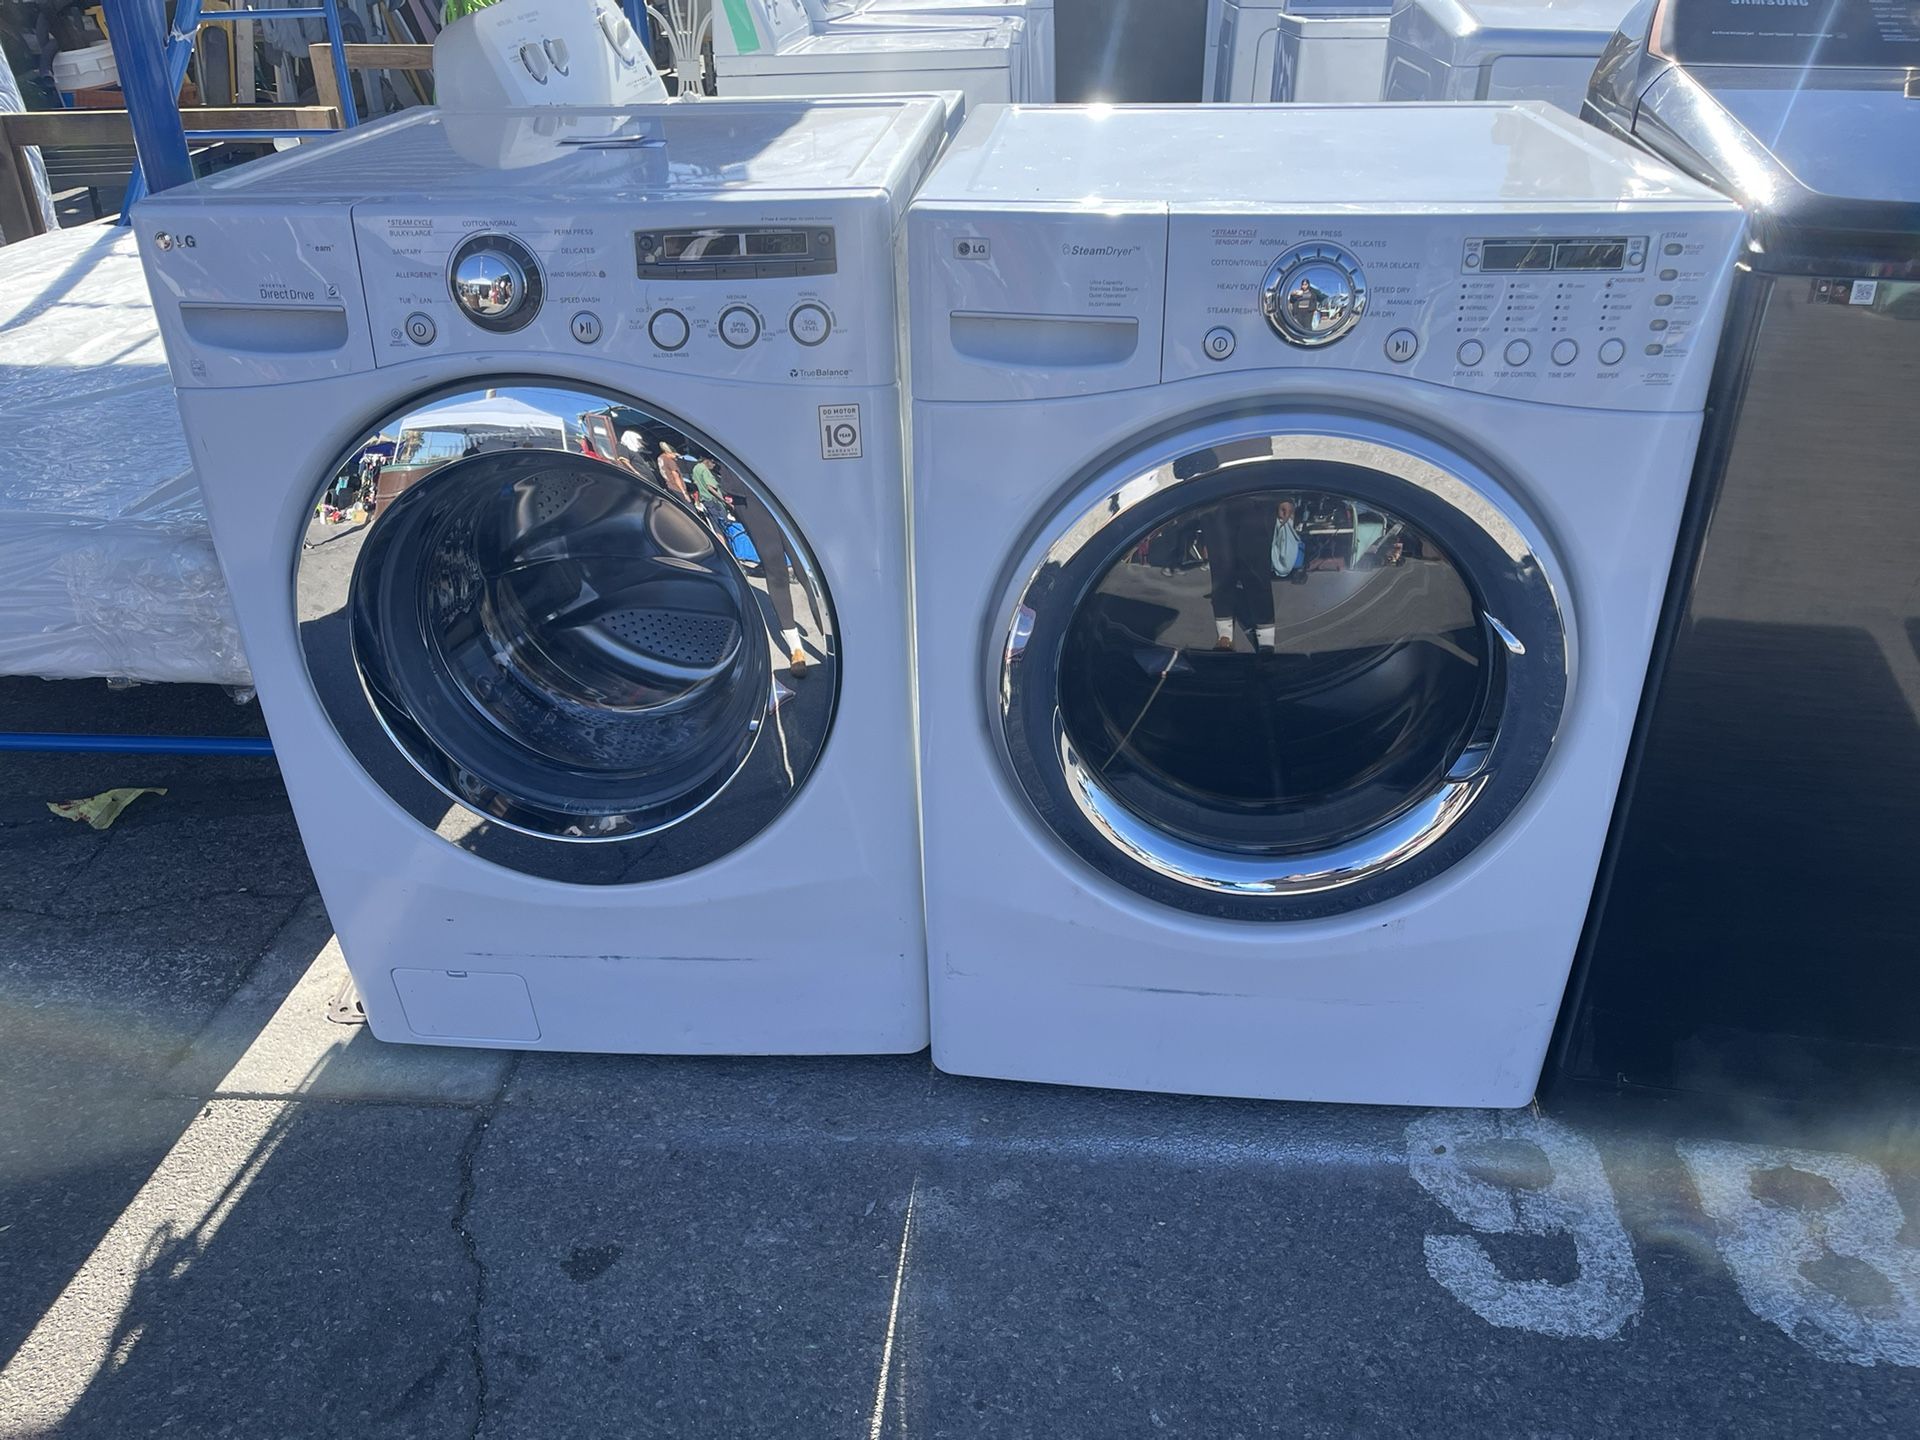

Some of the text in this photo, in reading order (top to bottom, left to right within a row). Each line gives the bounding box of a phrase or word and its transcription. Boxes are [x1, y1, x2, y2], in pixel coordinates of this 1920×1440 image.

[1320, 230, 1343, 238] PRESS
[175, 235, 197, 249] LG
[1260, 239, 1289, 247] NORMAL
[392, 248, 422, 256] SANITARY
[560, 247, 596, 255] DELICATES
[972, 244, 986, 254] LG
[1210, 259, 1268, 267] COTTON/TOWELS
[559, 296, 601, 304] SPEED WASH
[825, 423, 856, 448] 10
